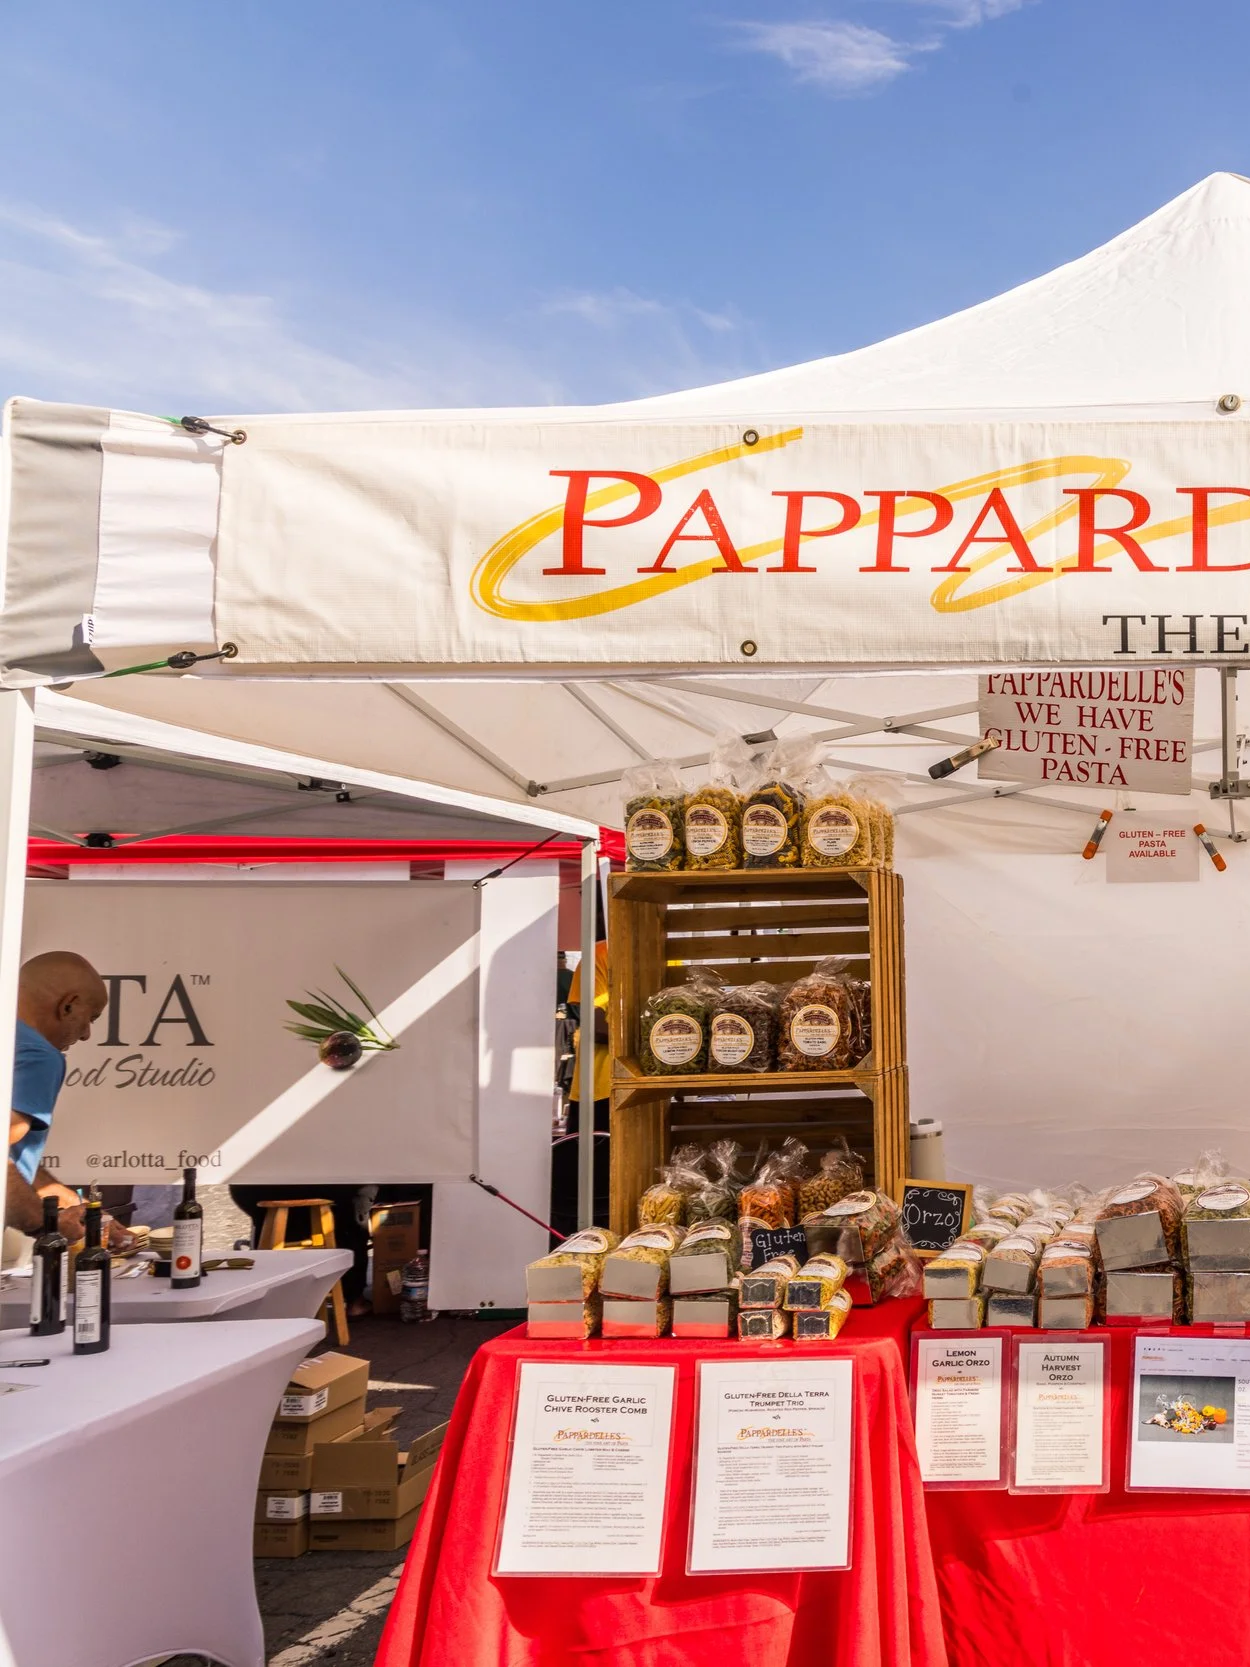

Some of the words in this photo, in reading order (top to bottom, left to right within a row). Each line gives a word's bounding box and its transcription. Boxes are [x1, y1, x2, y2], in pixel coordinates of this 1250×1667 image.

[1102, 613, 1249, 655] THE
[986, 669, 1185, 706] PAPPARDELLE'S
[1014, 701, 1062, 726] WE
[1076, 705, 1154, 732] HAVE
[984, 727, 1097, 757] GLUTEN
[1118, 736, 1187, 763] FREE
[1040, 757, 1129, 786] PASTA
[1119, 830, 1154, 839] GLUTEN
[1163, 830, 1186, 838] FREE
[1138, 840, 1167, 848] PASTA
[1128, 849, 1176, 858] AVAILABLE
[190, 975, 211, 985] TM
[115, 1053, 216, 1089] Studio
[86, 1150, 222, 1170] @arlotta_food
[906, 1203, 955, 1227] Orzo
[755, 1229, 806, 1248] Gluten
[932, 1359, 964, 1367] GARLIC
[1044, 1354, 1080, 1362] AUTUMN
[546, 1395, 610, 1403] GLUTEN-FREE
[612, 1396, 647, 1404] GARLIC
[724, 1391, 777, 1399] GLUTEN-FREE
[544, 1405, 573, 1413] CHIVE
[574, 1405, 618, 1414] ROOSTER
[620, 1406, 648, 1414] COMB
